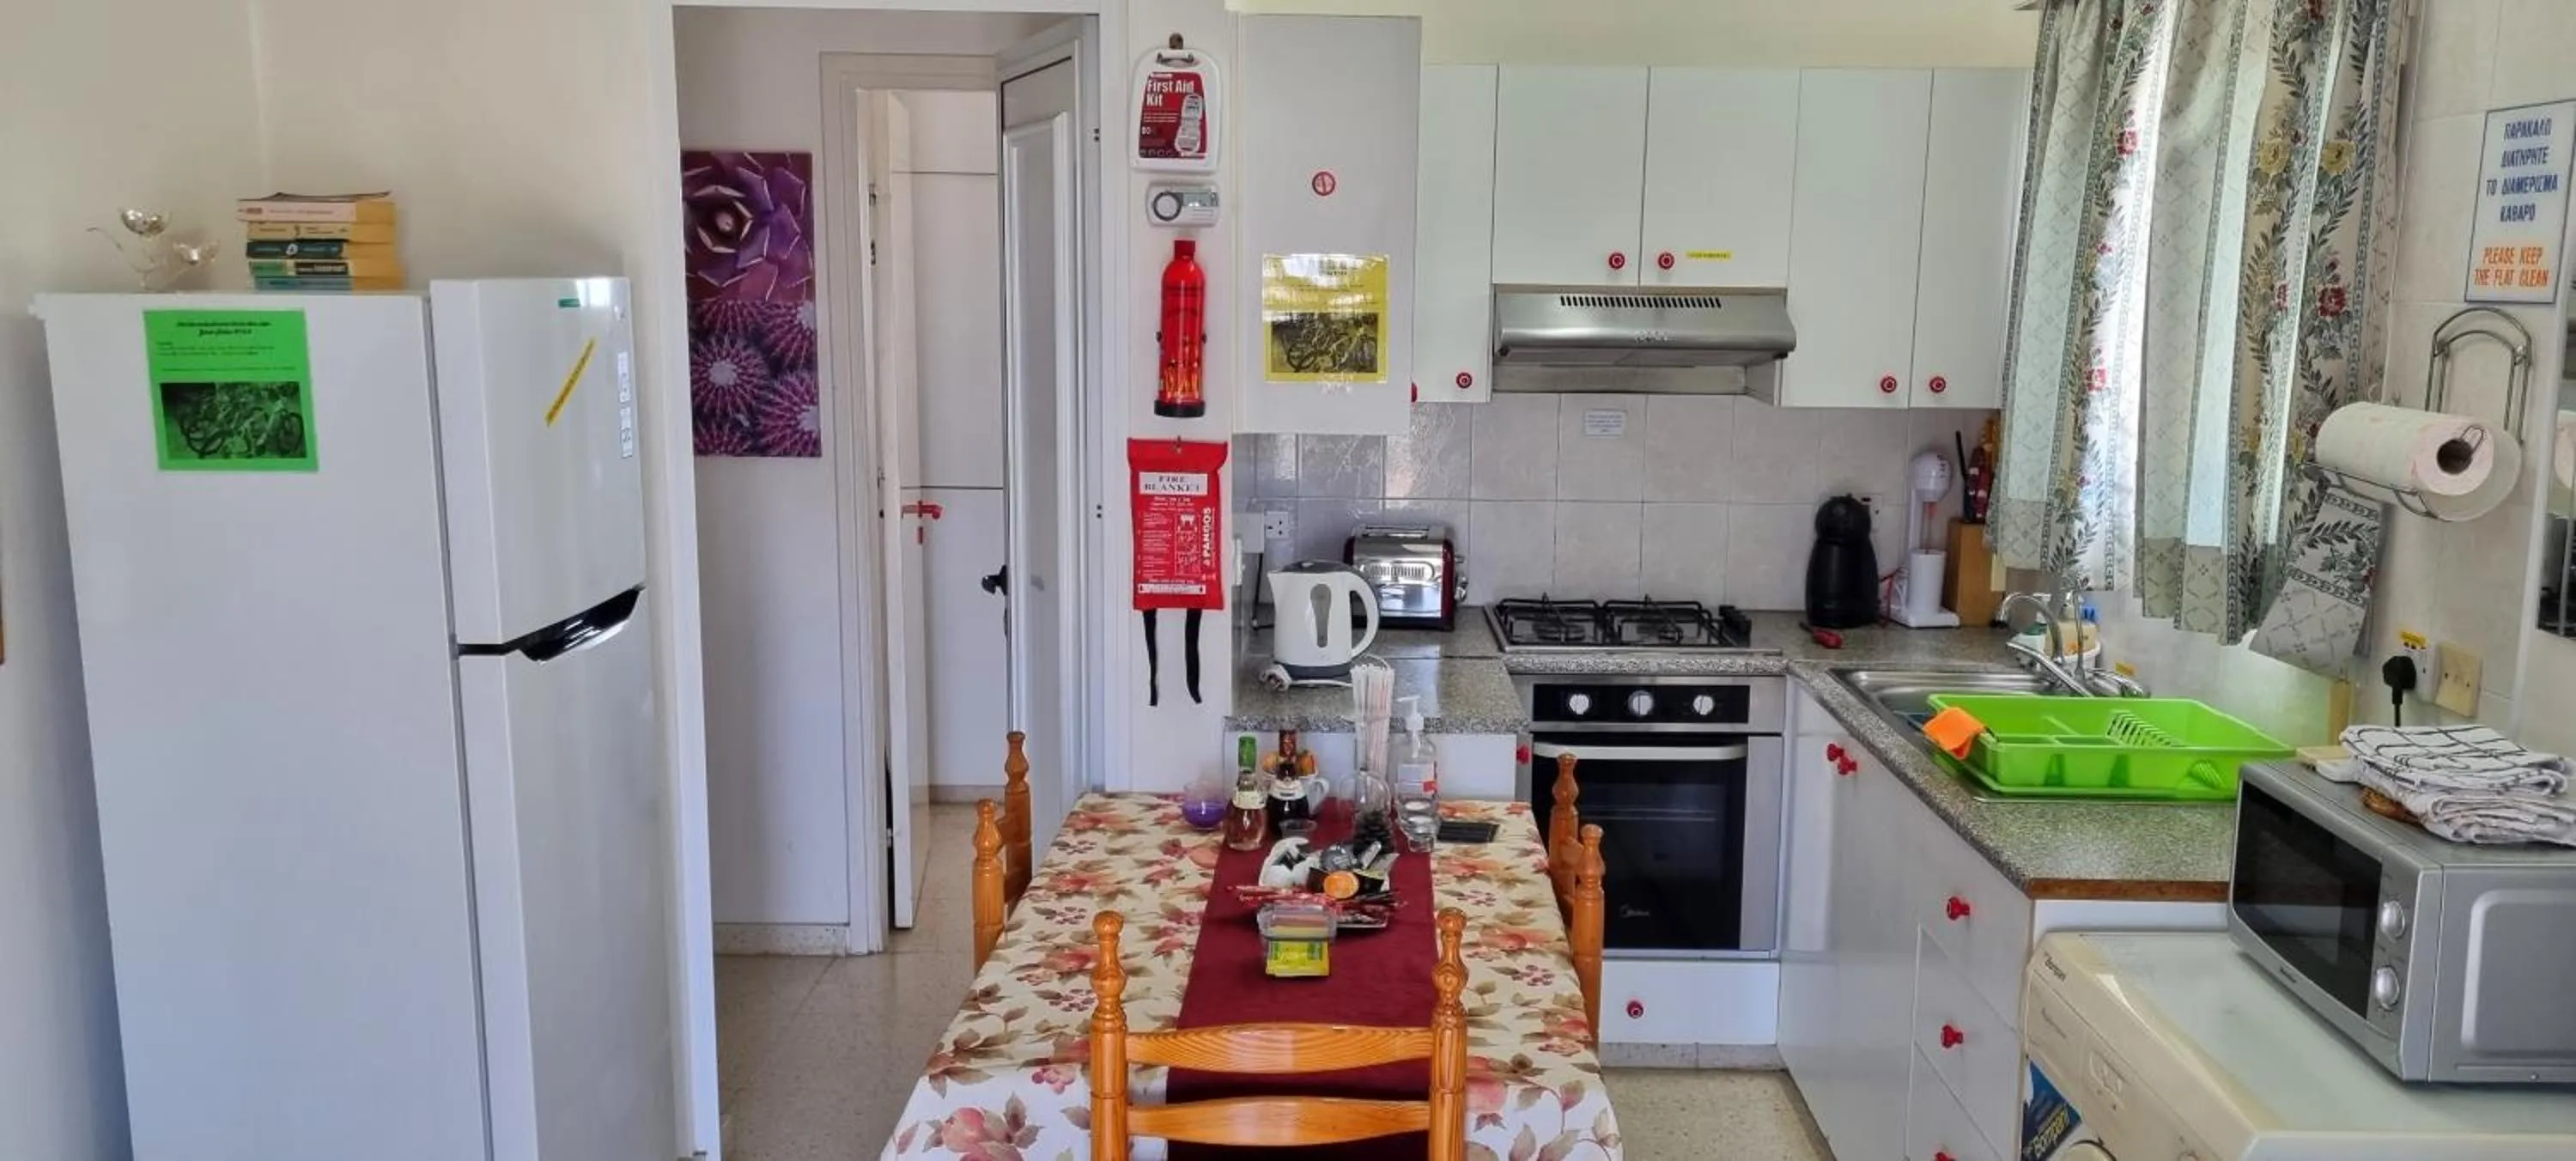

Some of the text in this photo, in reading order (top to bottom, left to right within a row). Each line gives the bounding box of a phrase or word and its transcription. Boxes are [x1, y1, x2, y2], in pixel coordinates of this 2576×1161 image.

[1147, 79, 1194, 94] First Aid
[1146, 94, 1163, 106] Kit
[2483, 246, 2543, 264] PLEASE KEEP
[2474, 268, 2549, 287] THE FLAT CLEAN
[1159, 475, 1185, 483] FIRE
[1145, 483, 1200, 492] BLANKET
